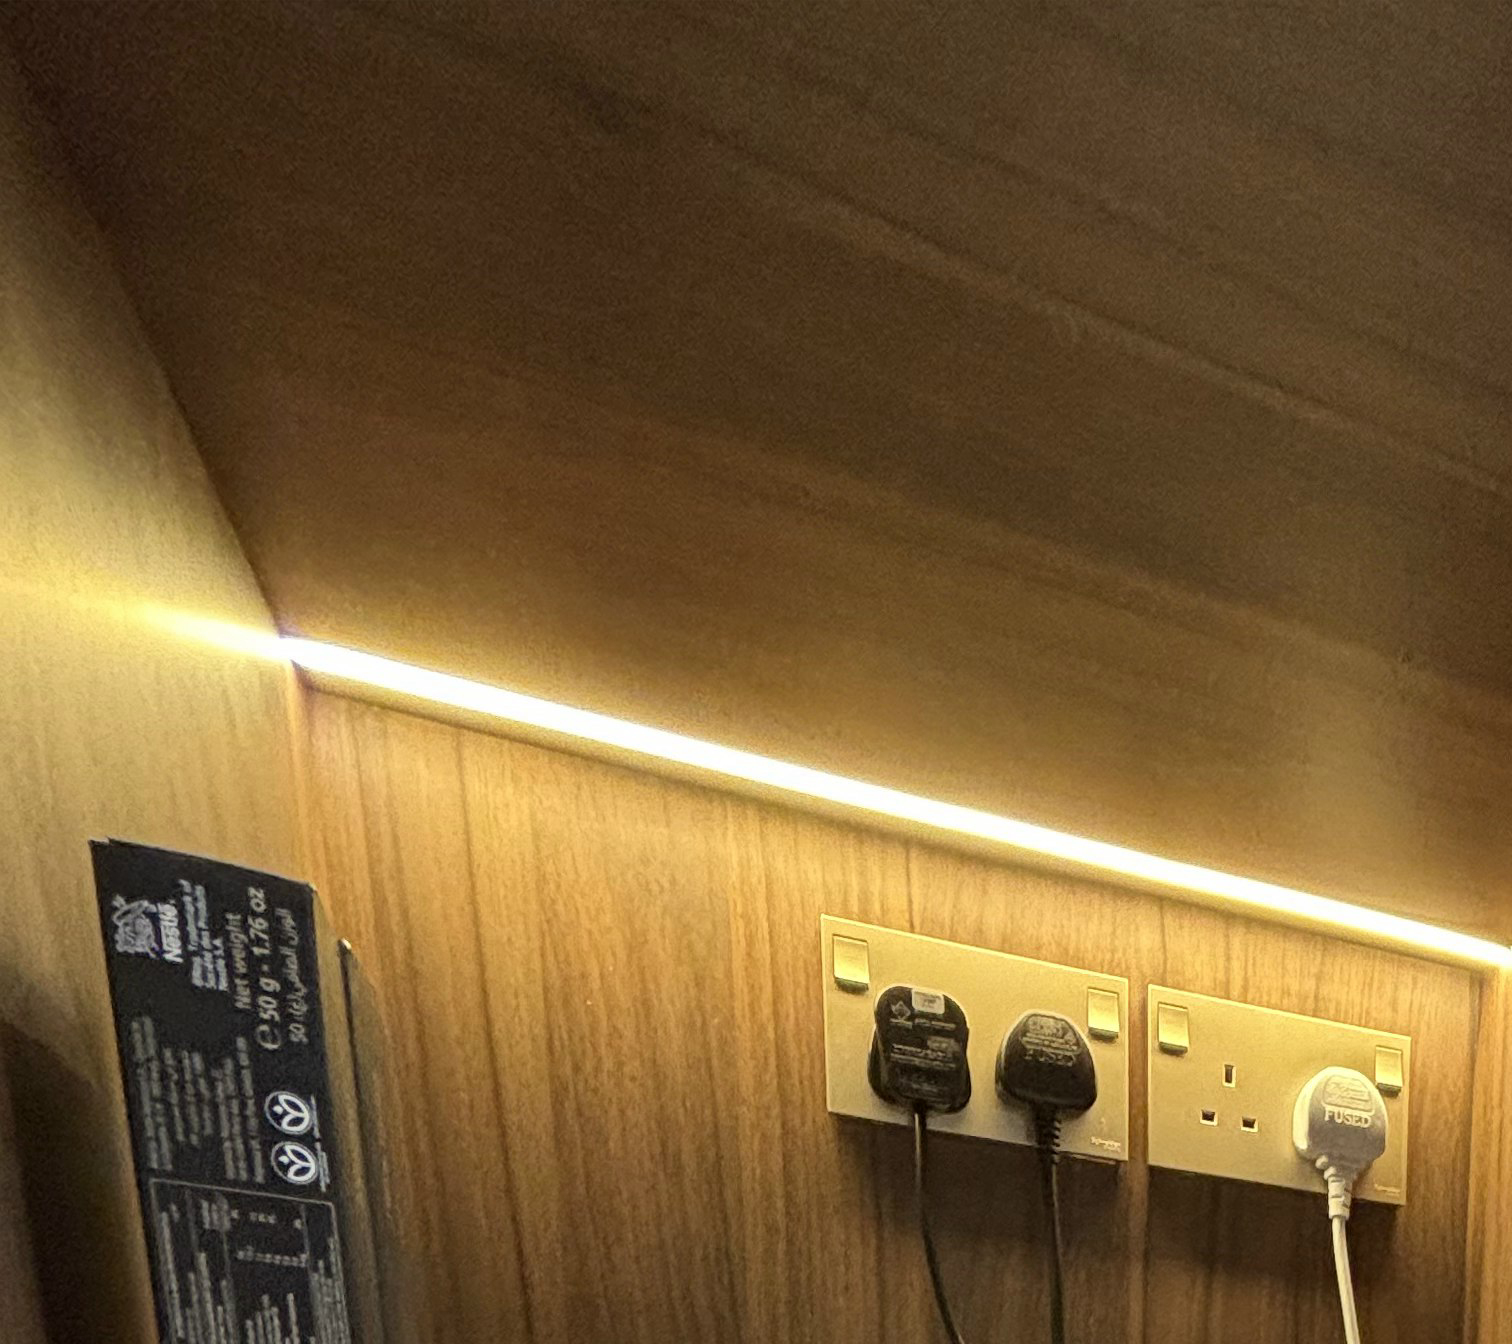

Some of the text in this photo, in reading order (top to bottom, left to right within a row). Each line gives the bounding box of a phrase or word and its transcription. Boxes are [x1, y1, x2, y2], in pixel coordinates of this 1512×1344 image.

[248, 886, 267, 914] oz
[248, 914, 272, 956] 1.76
[260, 977, 281, 993] g
[257, 995, 280, 1022] 50
[1324, 1107, 1372, 1128] FUSED
